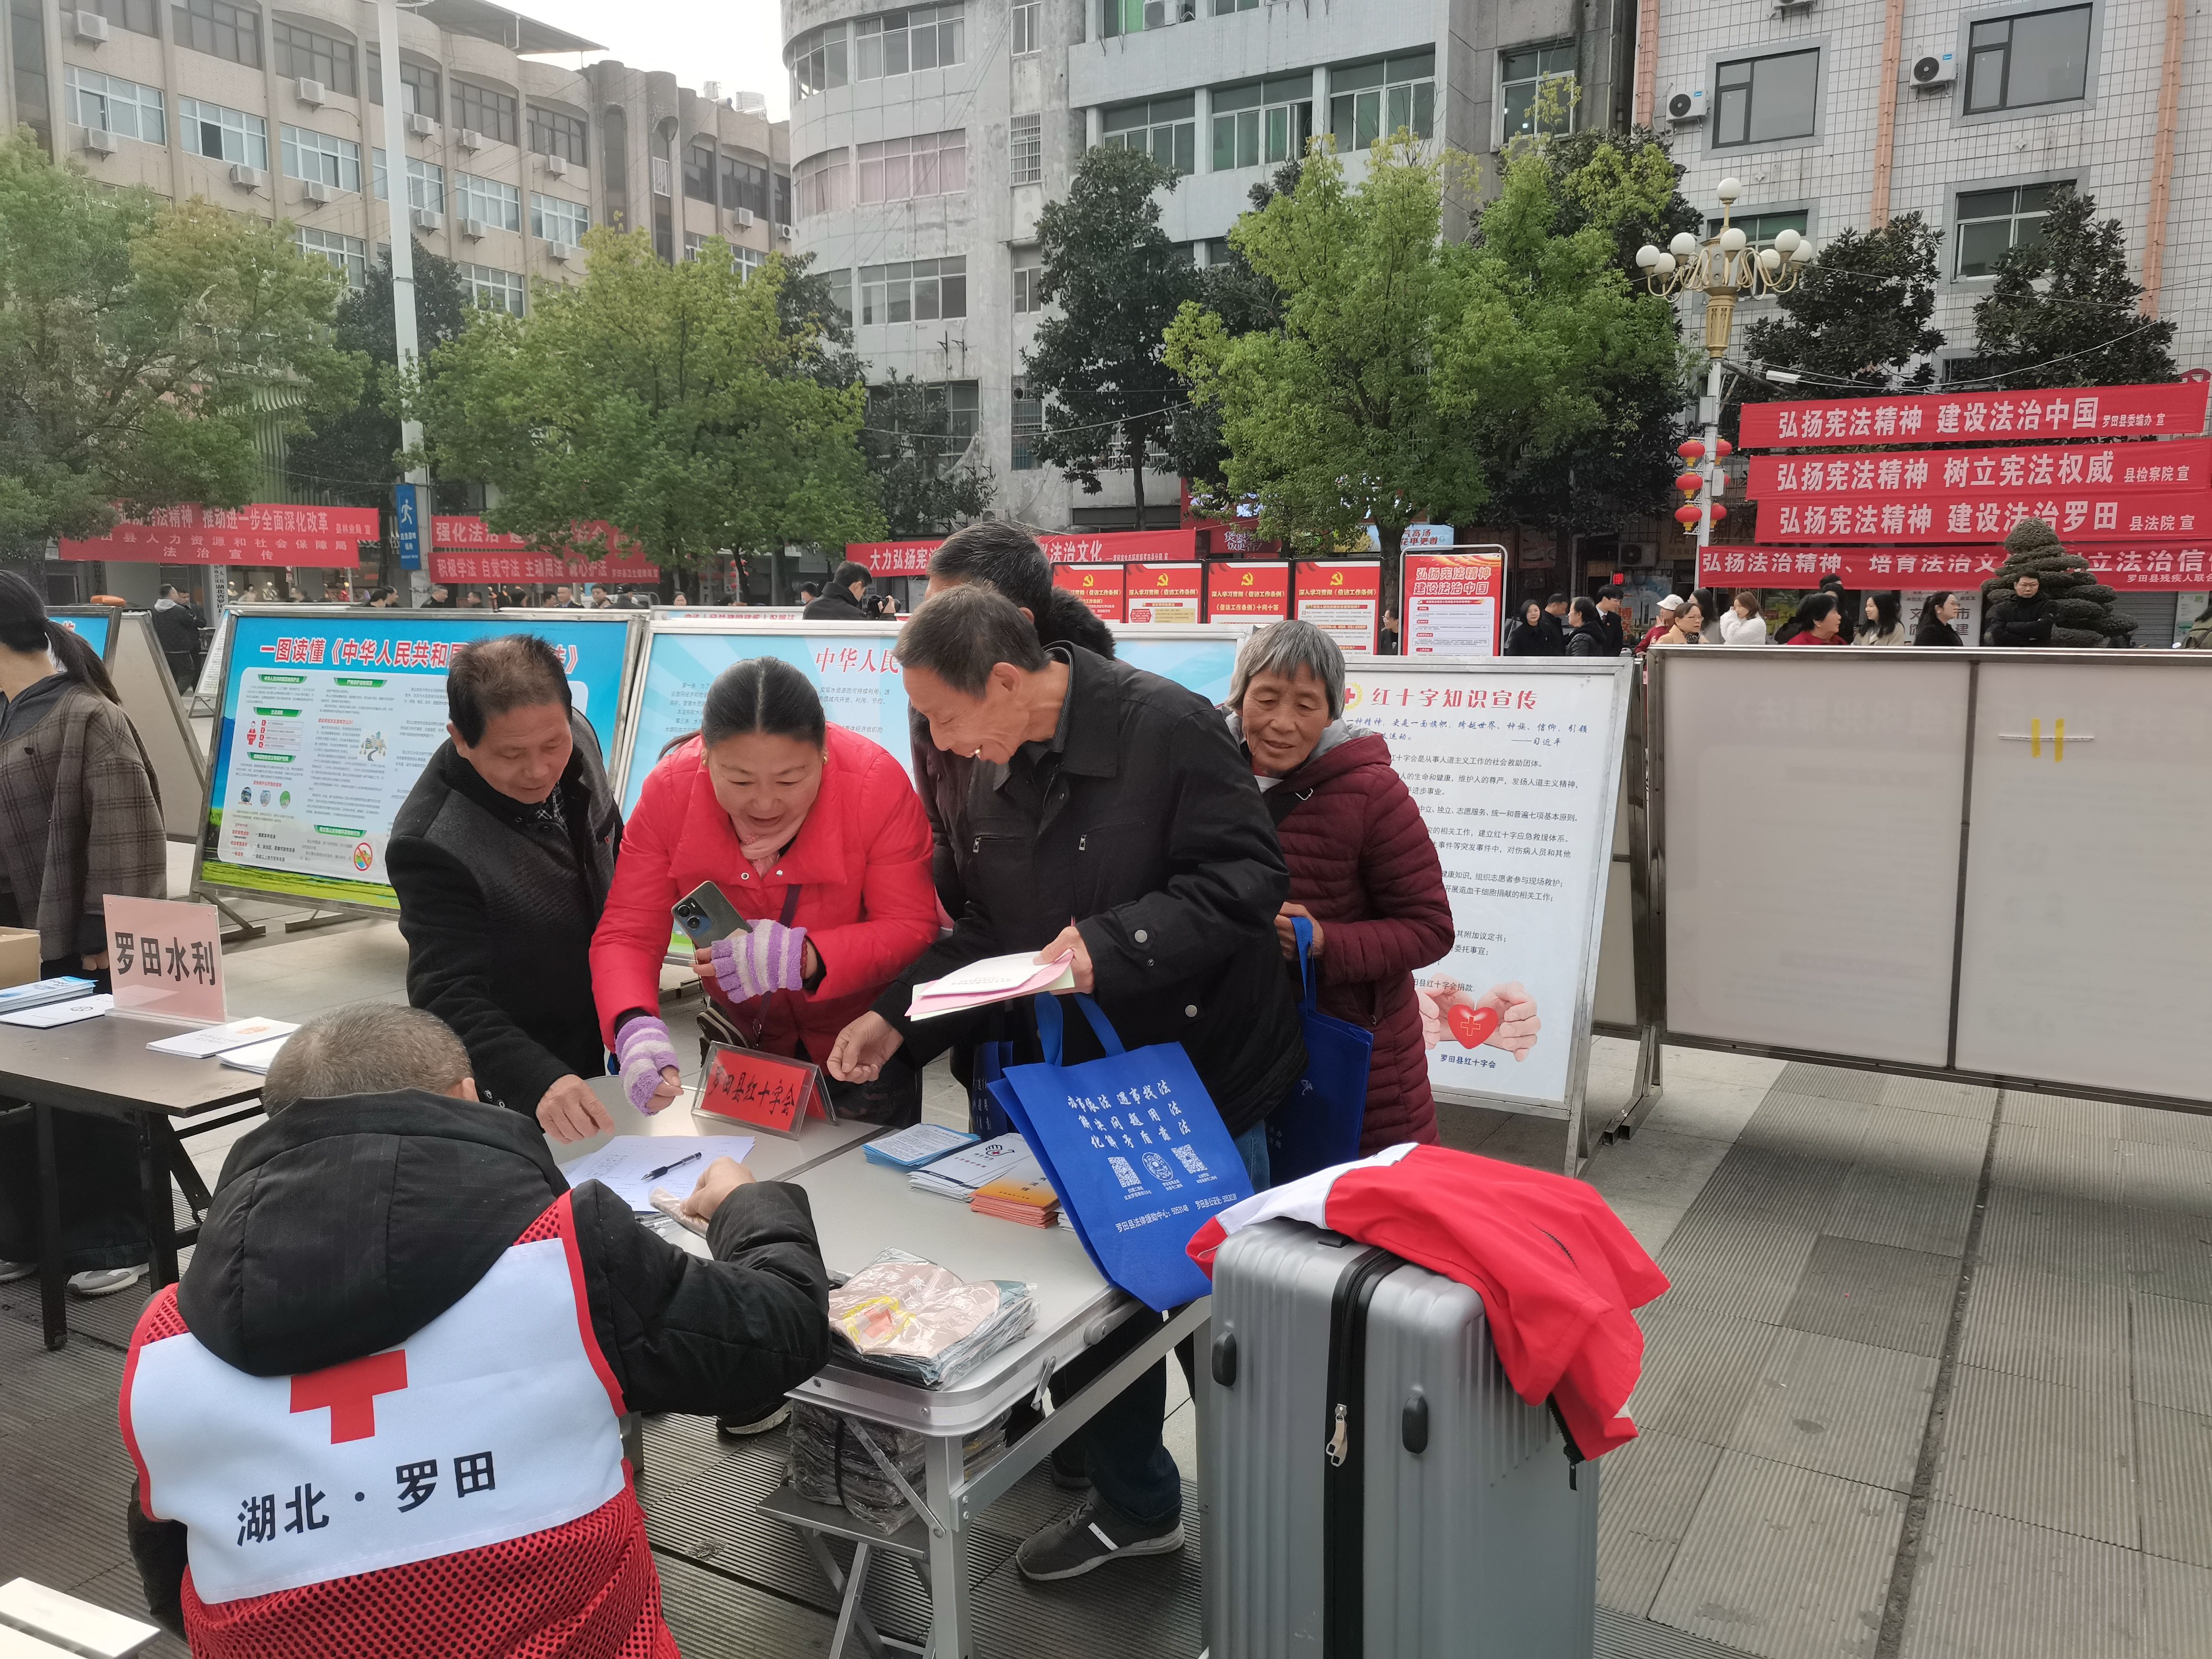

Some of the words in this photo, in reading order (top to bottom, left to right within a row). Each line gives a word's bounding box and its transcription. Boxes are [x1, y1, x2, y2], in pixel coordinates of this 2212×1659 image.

[1779, 404, 1923, 440] 弘扬宪法精神
[1936, 397, 2099, 433] 建设法治中国
[2102, 413, 2152, 428] 罗田县委编办
[2156, 412, 2165, 427] 宣
[1777, 457, 1929, 492] 弘扬宪法精神
[1943, 450, 2115, 488] 树立宪法权威
[2123, 466, 2174, 483] 县检察院
[2176, 465, 2190, 481] 宣
[202, 506, 329, 534] 推动进一步全面深化改革
[1779, 503, 1933, 535] 弘扬宪法精神
[1947, 500, 2118, 533] 建设法治罗田
[2128, 515, 2175, 531] 县法院
[2179, 514, 2194, 530] 宣
[163, 546, 274, 561] 法治宣传
[436, 558, 478, 577] 积极学法
[481, 558, 521, 577] 自觉守法
[1416, 566, 1492, 581] 弘扬宪法精神
[1413, 581, 1490, 596] 建设法治中国
[1370, 687, 1539, 710] 红十字知识宣传
[1397, 772, 1578, 789] 人的生命和健康,维护人的尊严,发扬人道主义精神,
[114, 931, 216, 986] 罗田水利
[1451, 944, 1489, 956] 委托事宜;
[1440, 1054, 1496, 1069] 罗田县红十字会
[707, 1065, 795, 1117] 罗田县红十字会
